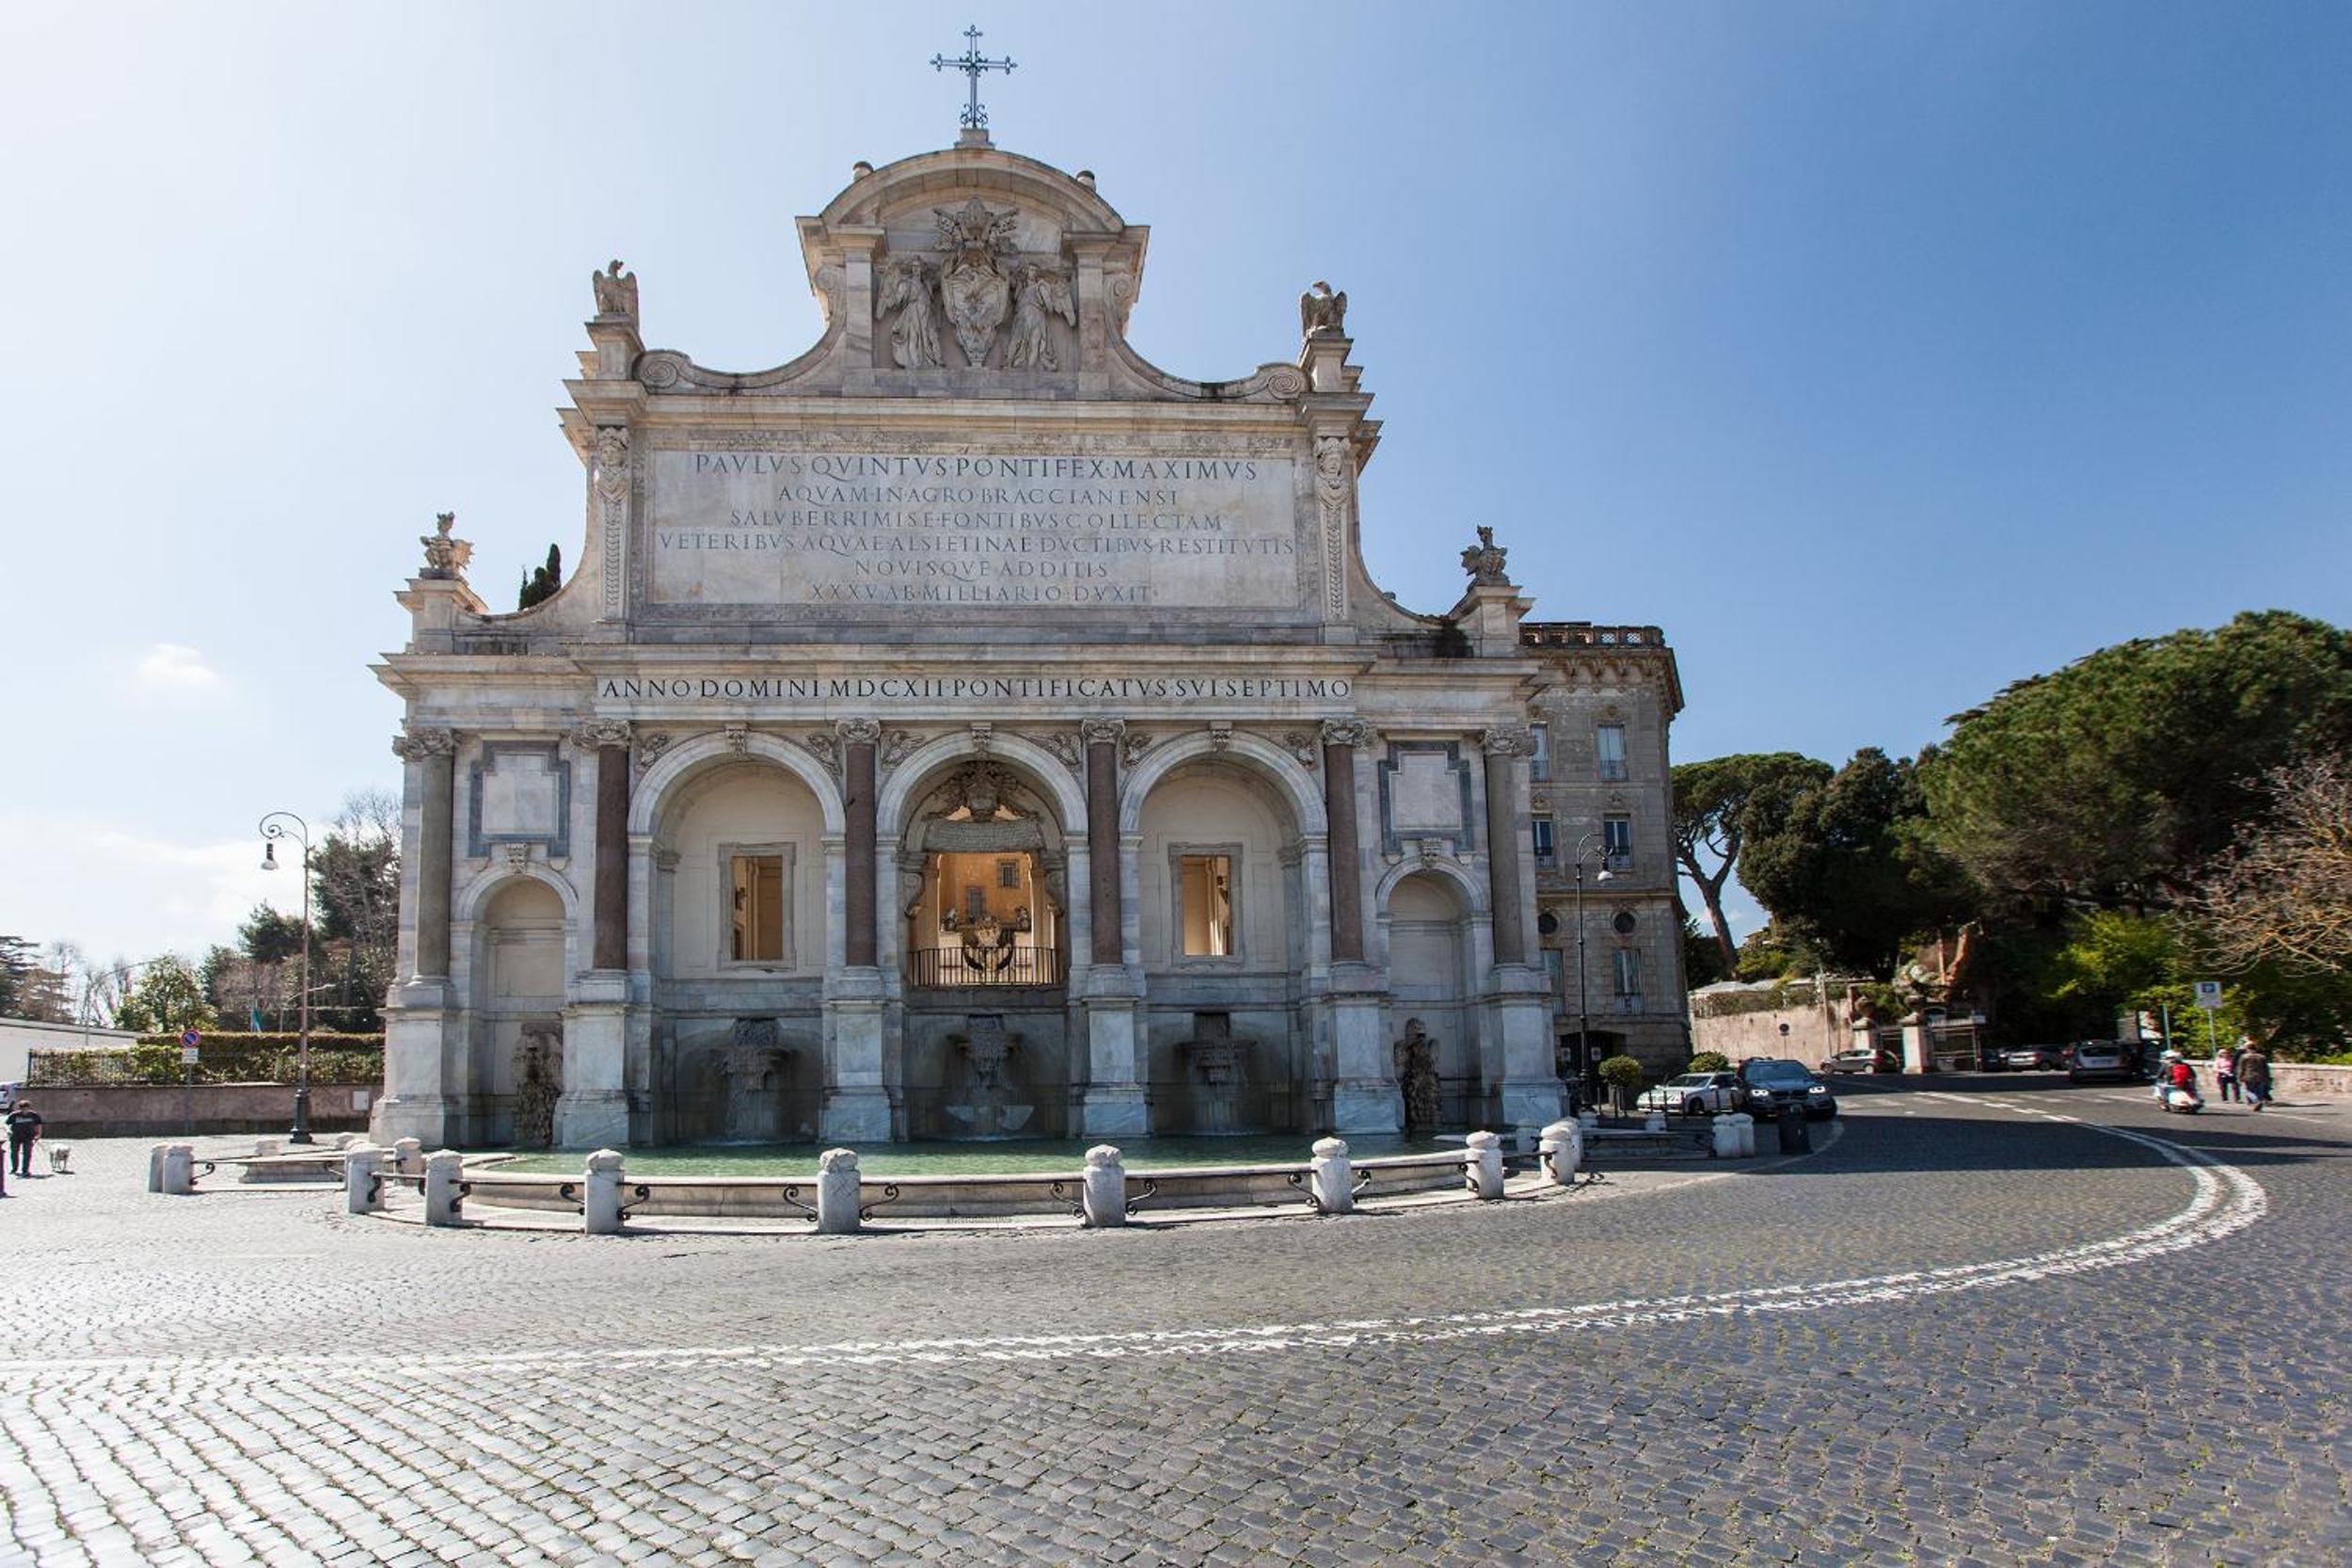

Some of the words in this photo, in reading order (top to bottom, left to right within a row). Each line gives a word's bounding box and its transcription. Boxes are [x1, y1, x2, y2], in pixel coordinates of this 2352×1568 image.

[696, 453, 801, 475] PAVLVS
[812, 456, 946, 482] QVINTVS
[956, 457, 1105, 478] PONTIFEX
[1113, 460, 1257, 481] MAXIMVS
[779, 485, 868, 507] AQVAM
[876, 487, 903, 503] IN
[907, 487, 973, 503] AGRO
[981, 488, 1176, 505] BRACCIANENSI
[730, 510, 917, 528] SALVBERRIMIS
[941, 512, 1058, 529] FONTIBVS
[1066, 514, 1223, 531] COLLECTAM
[660, 532, 794, 550] VETERIBVS
[802, 534, 887, 557] AQVAE
[891, 535, 1031, 553] ALSIETINAE
[1041, 536, 1153, 554] DVCTIBVS
[1160, 538, 1294, 555] RESTITVTIS
[855, 560, 990, 582] NOVISQVE
[1001, 561, 1107, 578] ADDITIS
[812, 583, 877, 602] XXXV
[885, 584, 915, 602] AB
[923, 584, 1060, 602] MILLIARIO
[1074, 585, 1152, 603] DVXIT
[602, 678, 691, 698] ANNO
[700, 678, 819, 698] DOMINI
[830, 678, 943, 698] MDCXII
[953, 678, 1167, 698] PONTIFICATVS
[1175, 678, 1216, 698] SVI
[1225, 678, 1350, 698] SEPTIMO
